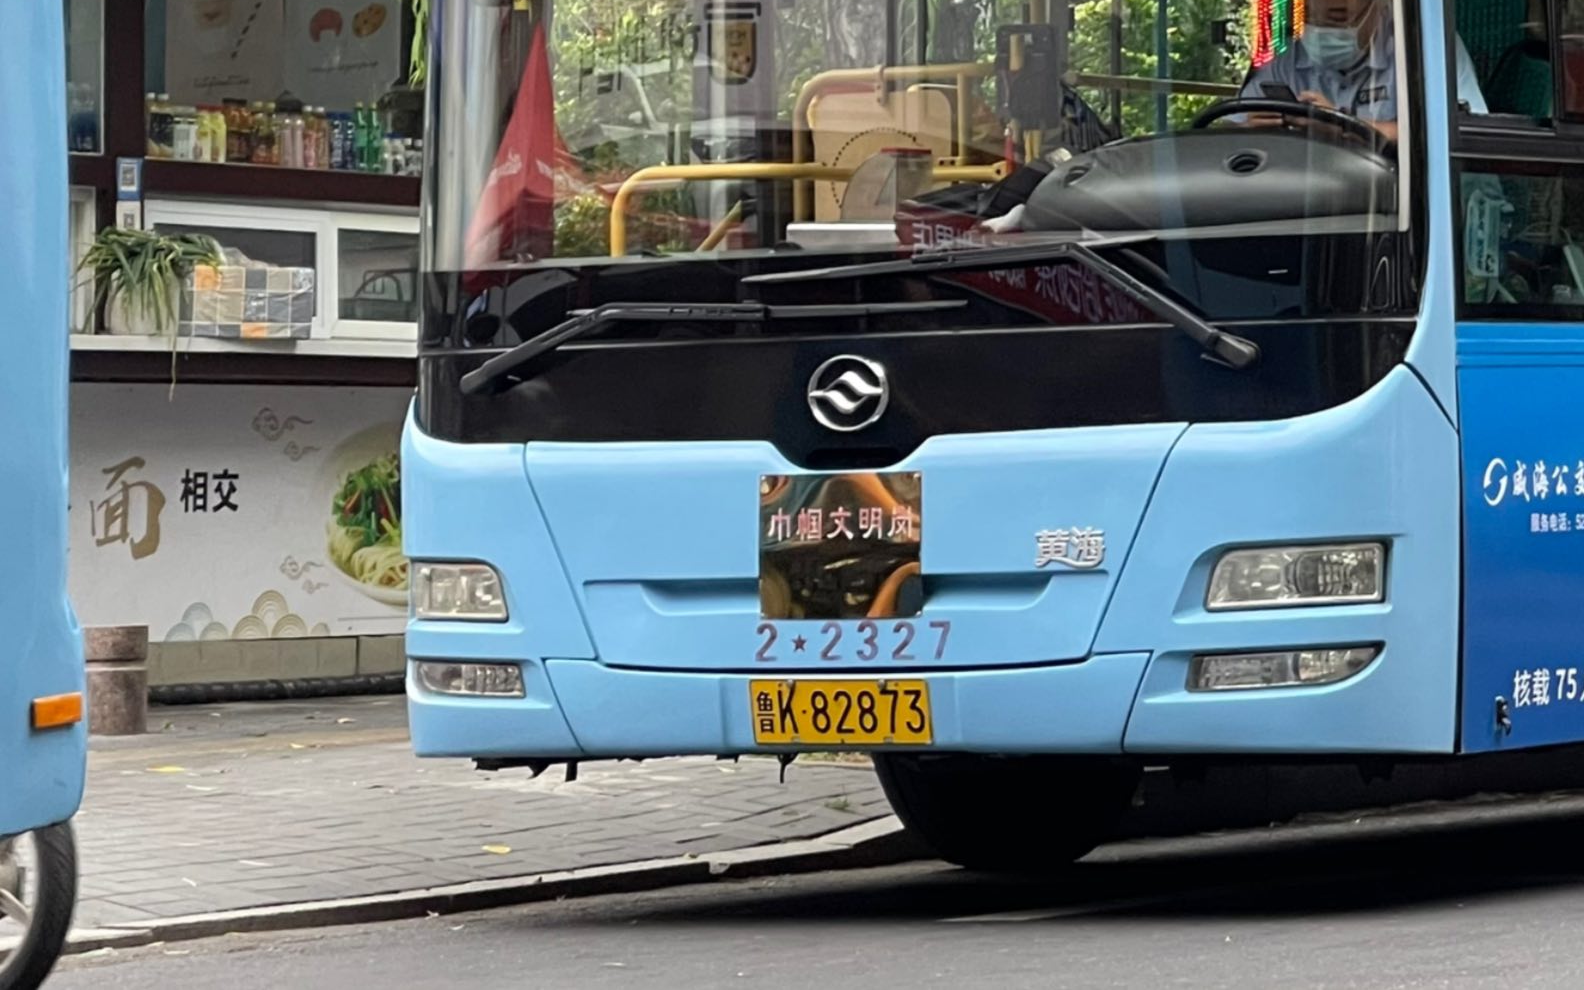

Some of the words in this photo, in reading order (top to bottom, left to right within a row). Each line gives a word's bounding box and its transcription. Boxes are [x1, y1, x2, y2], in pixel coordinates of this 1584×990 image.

[89, 456, 166, 559] 面
[180, 469, 239, 512] 相交
[767, 506, 914, 542] 巾帼文明岗
[1034, 525, 1106, 568] 黄海
